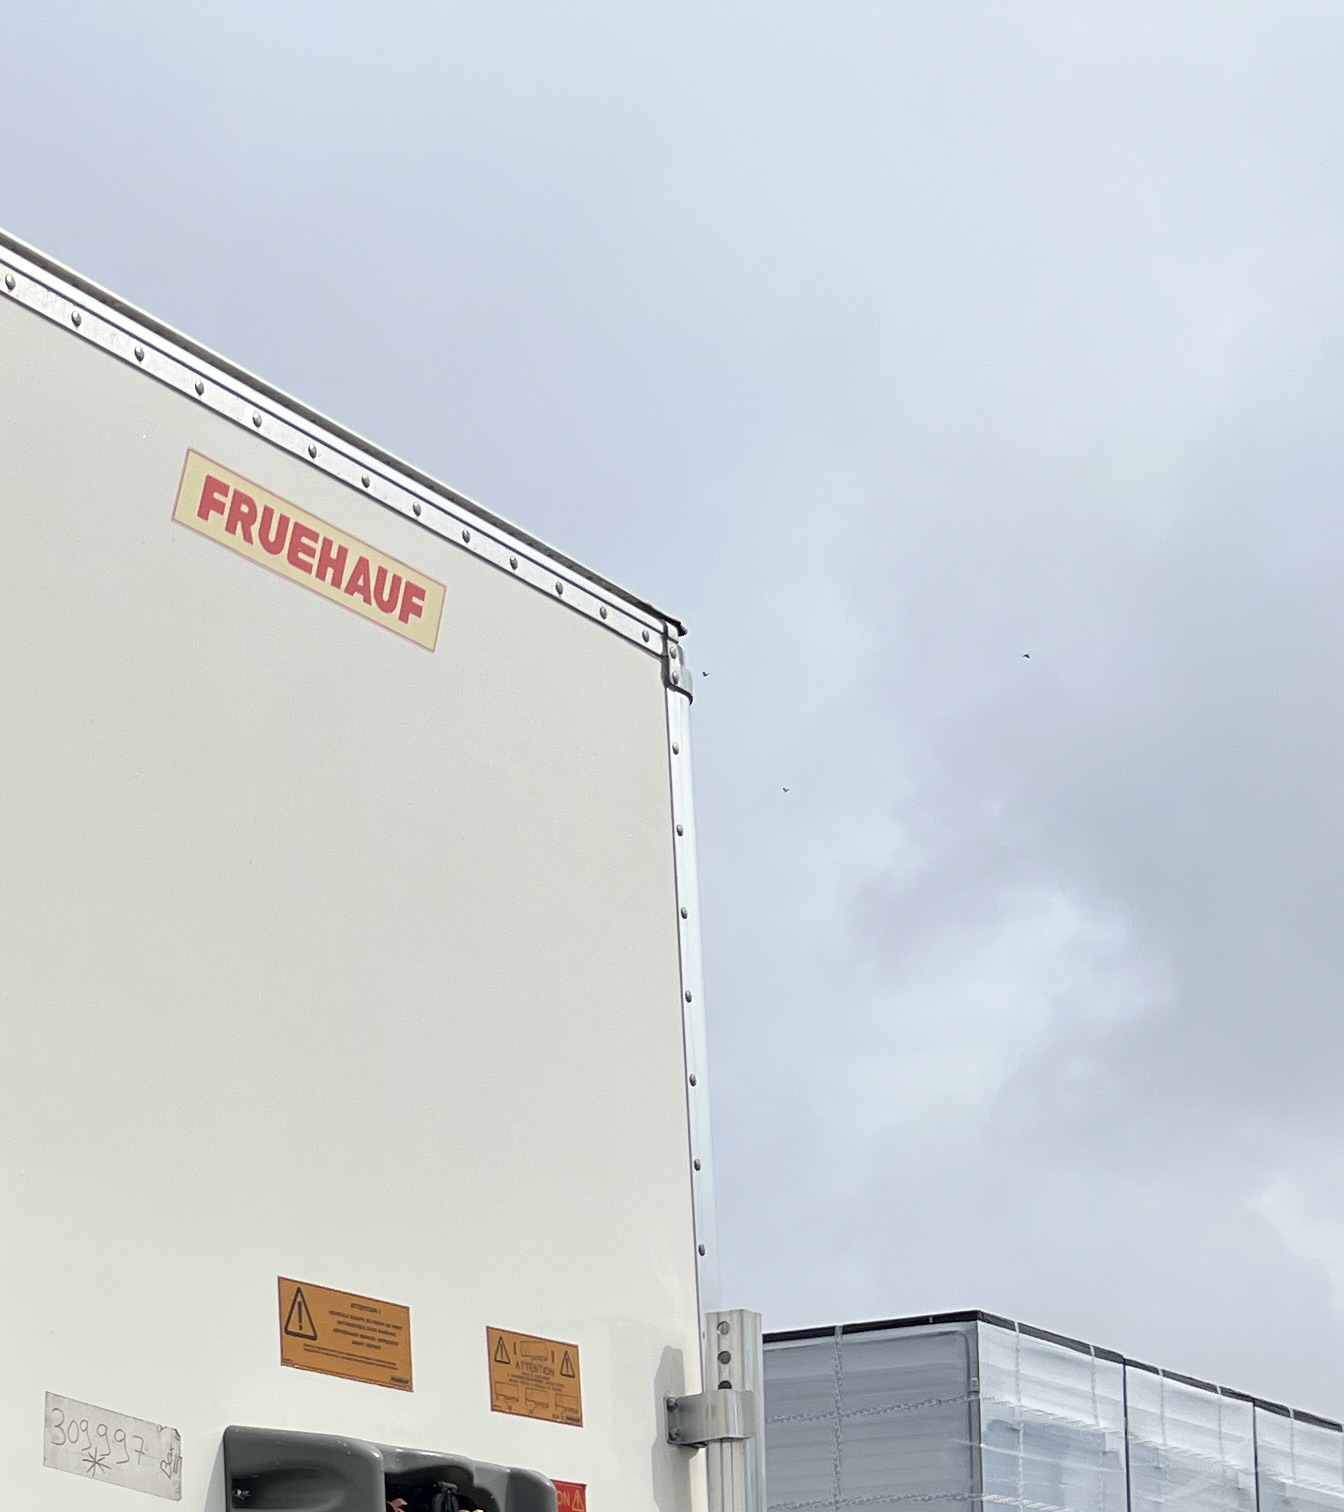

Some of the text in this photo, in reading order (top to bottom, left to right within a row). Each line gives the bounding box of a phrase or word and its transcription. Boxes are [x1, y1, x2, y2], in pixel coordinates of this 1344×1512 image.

[196, 474, 427, 625] FRUEHAUF
[515, 1360, 555, 1377] ATTENTION
[50, 1407, 146, 1466] 309997
